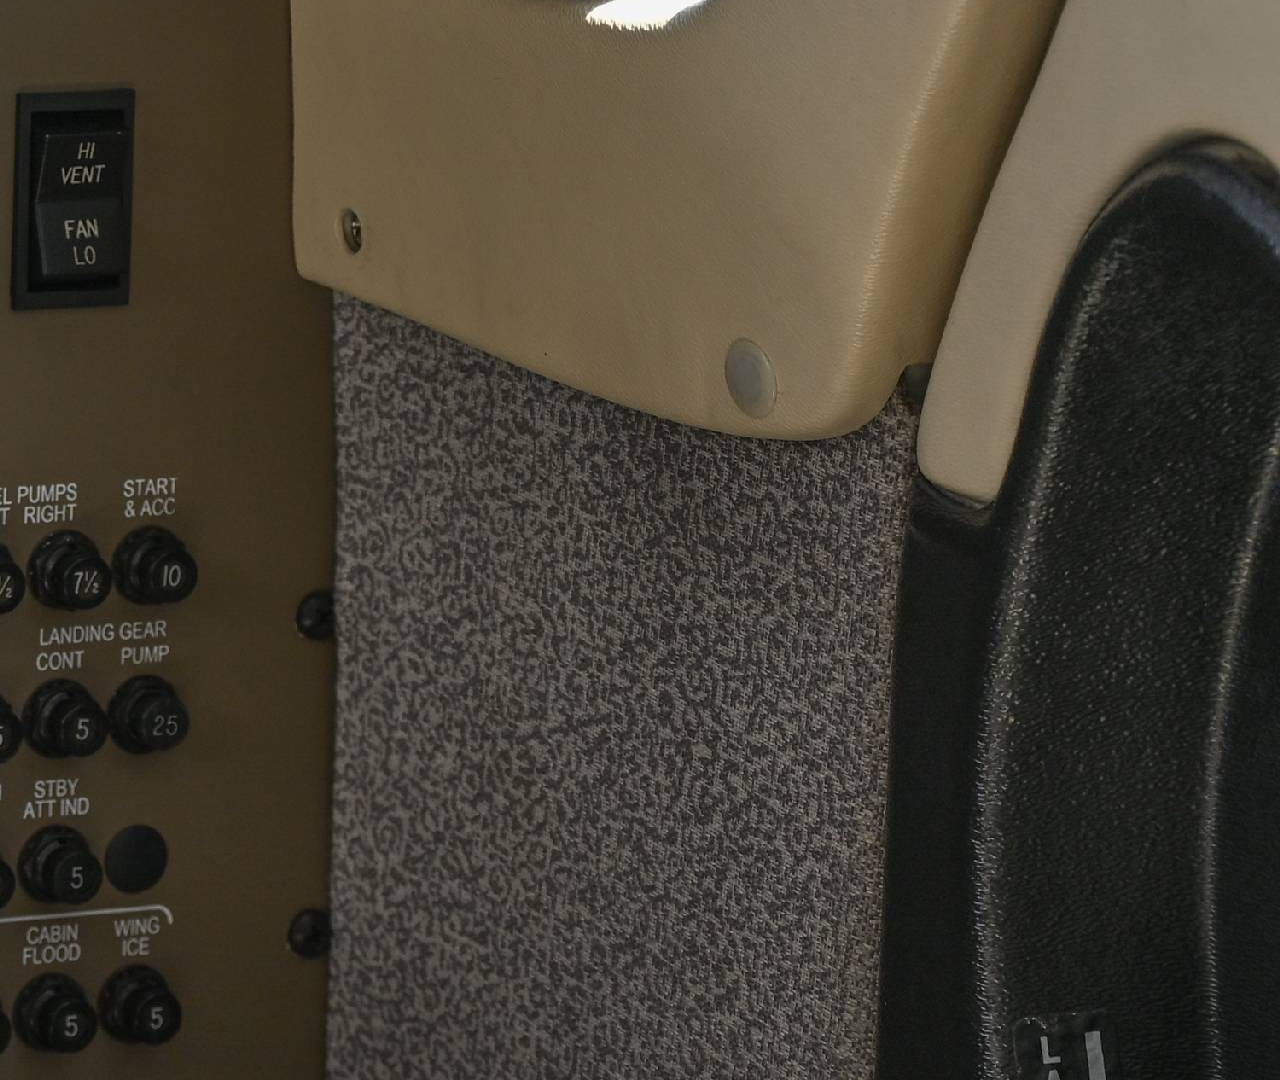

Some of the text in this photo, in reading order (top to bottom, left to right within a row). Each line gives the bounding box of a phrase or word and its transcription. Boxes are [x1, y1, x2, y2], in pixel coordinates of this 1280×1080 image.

[78, 142, 95, 160] HI
[62, 165, 105, 185] VENT
[64, 219, 99, 240] FAN
[74, 246, 96, 265] LO
[17, 483, 77, 504] PUMPS
[24, 504, 77, 524] RIGHT
[40, 621, 167, 646] LANDING GEAR
